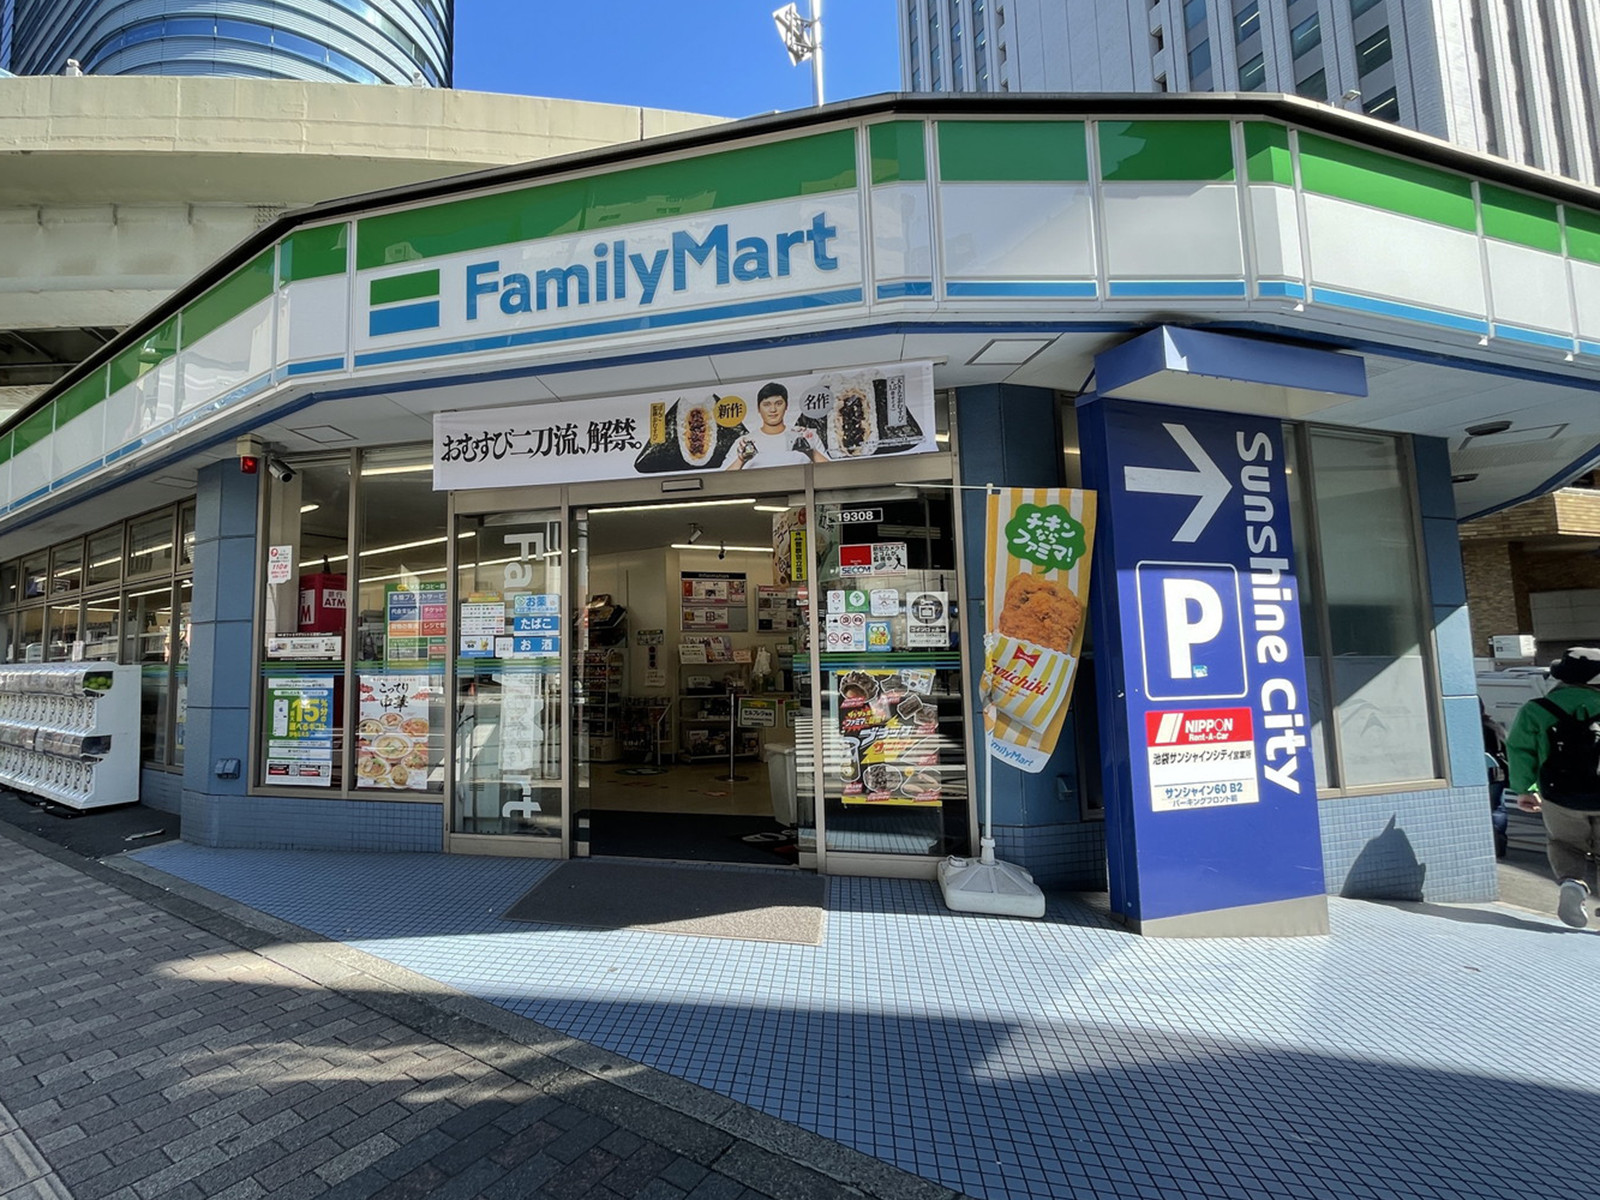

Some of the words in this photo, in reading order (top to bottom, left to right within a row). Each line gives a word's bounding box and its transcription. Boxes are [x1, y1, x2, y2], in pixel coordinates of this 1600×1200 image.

[466, 211, 839, 321] FamilyMart
[804, 393, 830, 410] 名作
[717, 402, 743, 419] 新作
[440, 417, 643, 463] おむすび二刀流、解禁。
[837, 511, 874, 522] 19308
[1026, 512, 1076, 538] チキン
[1035, 527, 1059, 544] なら
[1236, 431, 1292, 664] Sunshine
[841, 566, 871, 575] SECOM
[324, 598, 347, 607] ATM
[521, 618, 552, 630] たばこ
[1163, 578, 1223, 679] P
[379, 682, 409, 693] こってり
[291, 698, 320, 723] 15
[379, 694, 409, 713] 中華
[1185, 718, 1233, 733] NIPPON
[1188, 732, 1229, 742] Rent-A-Car
[990, 739, 1034, 767] milyMart
[1165, 784, 1227, 799] サンシャイン60
[1230, 782, 1243, 793] B2
